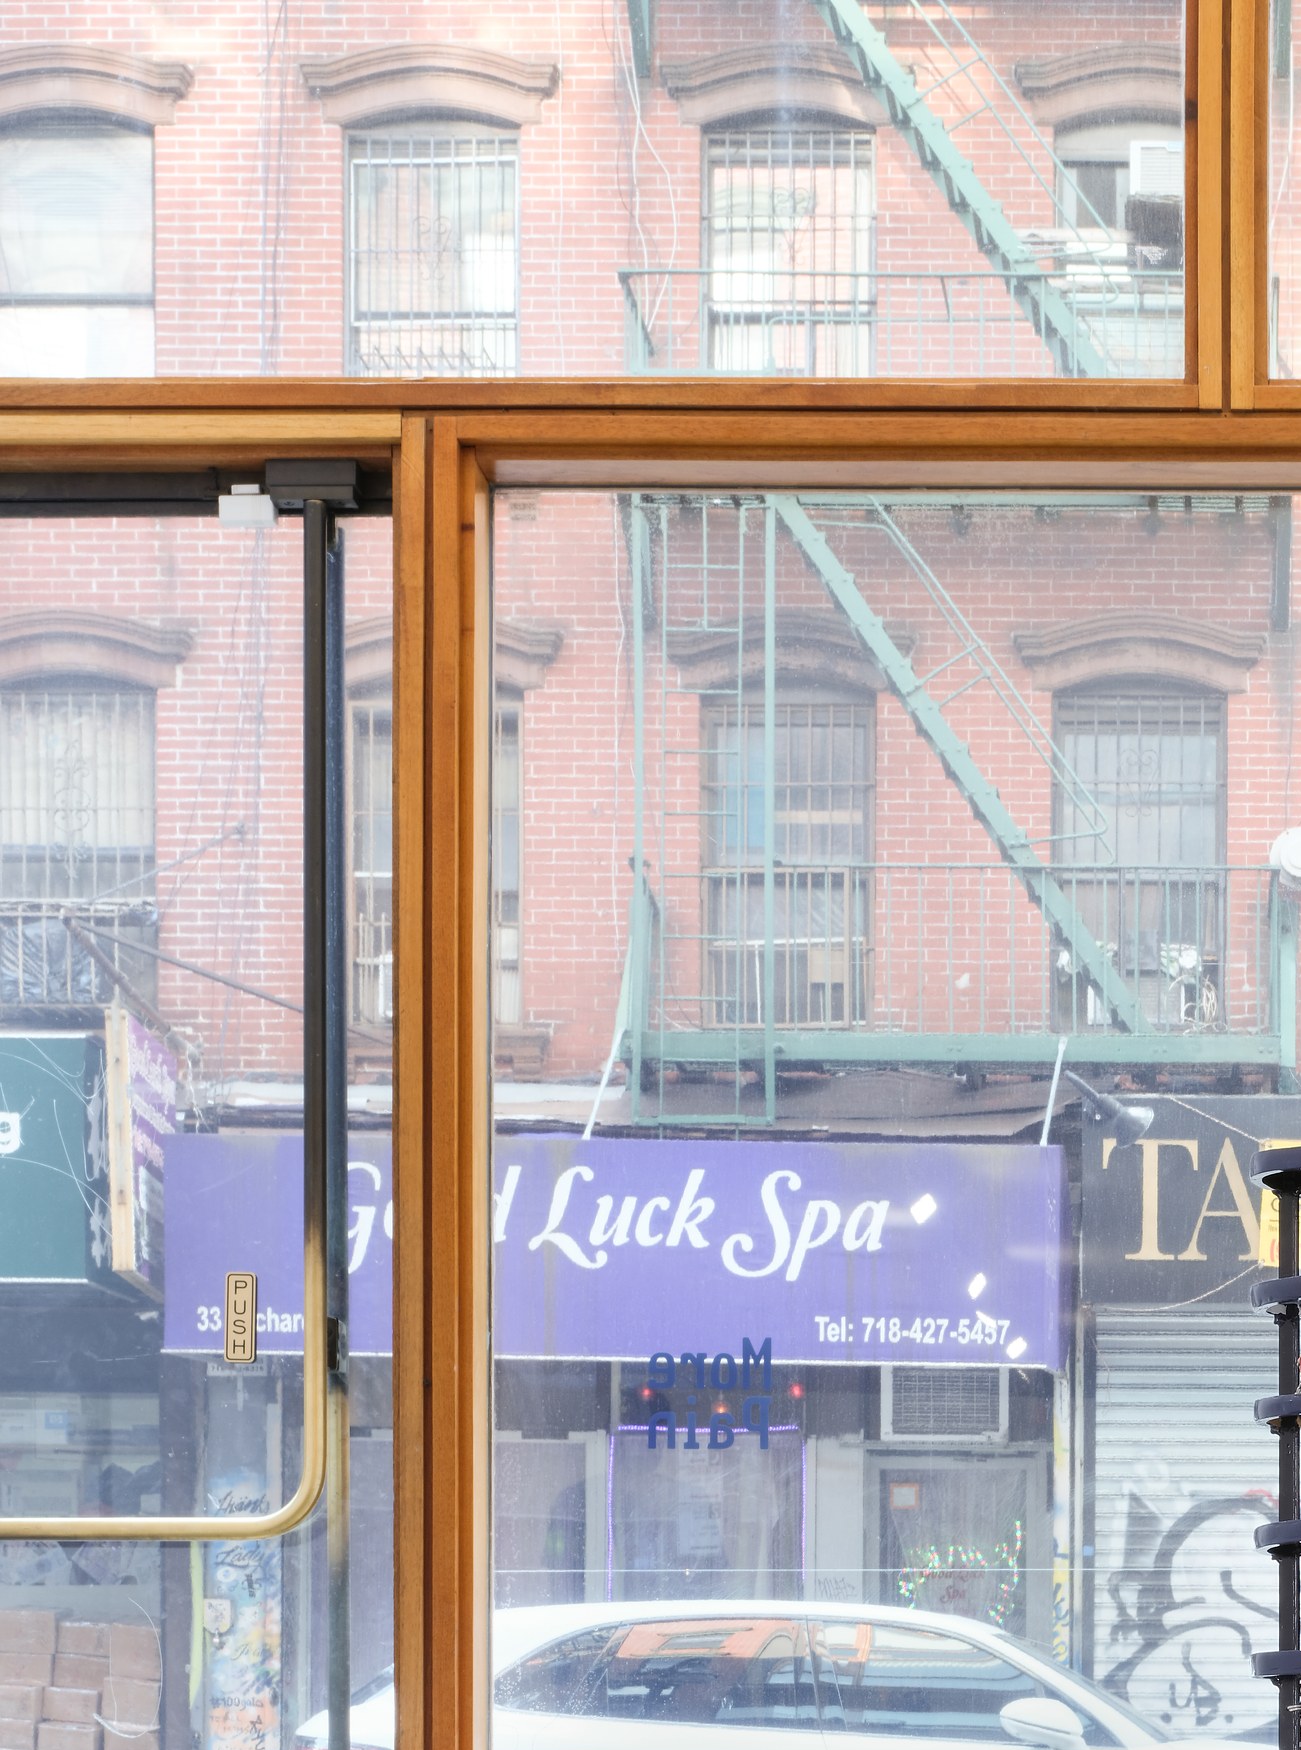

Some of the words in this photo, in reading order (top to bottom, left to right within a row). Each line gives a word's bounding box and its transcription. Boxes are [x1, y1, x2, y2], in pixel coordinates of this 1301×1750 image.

[347, 1161, 522, 1274] Gd
[528, 1166, 715, 1269] Luck
[721, 1170, 890, 1281] Spa
[196, 1306, 222, 1331] 33
[257, 1307, 304, 1332] char
[232, 1280, 248, 1354] PUSH
[815, 1316, 853, 1342] Tel:
[862, 1317, 1010, 1344] 718-427-5457
